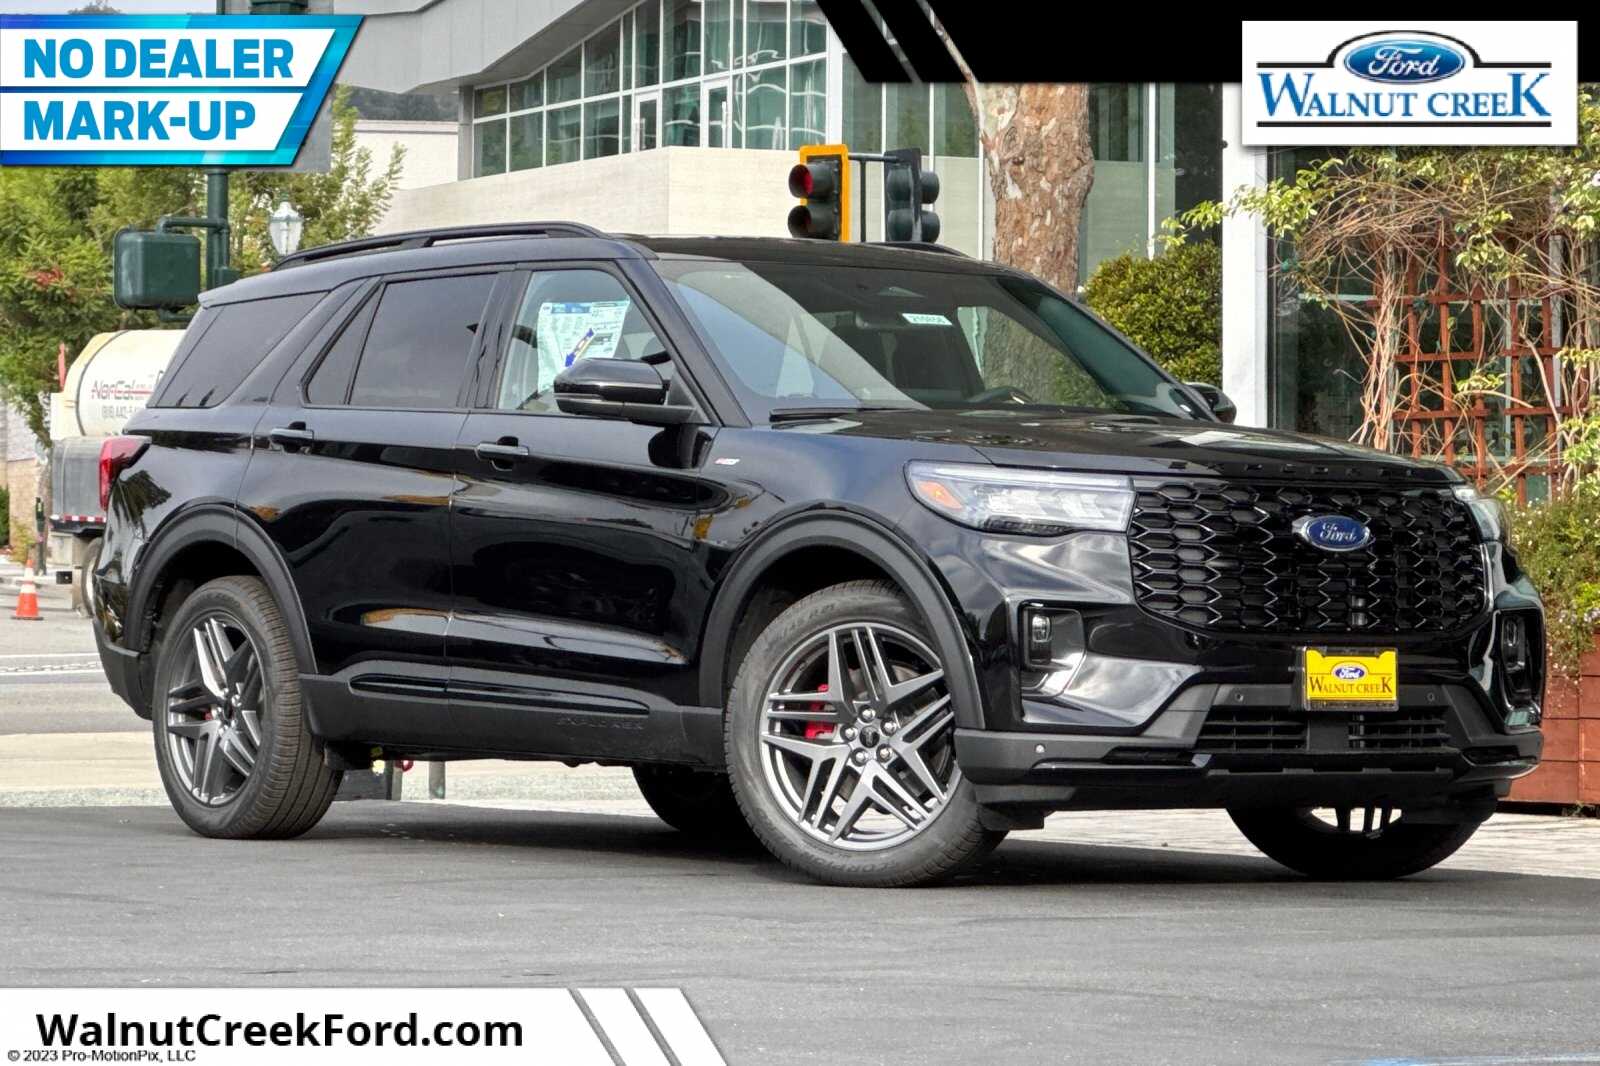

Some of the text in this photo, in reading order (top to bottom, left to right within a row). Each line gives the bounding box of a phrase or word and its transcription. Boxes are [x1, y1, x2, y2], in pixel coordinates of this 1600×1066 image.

[1319, 522, 1358, 542] Ford
[1339, 666, 1361, 679] Ford
[1308, 676, 1393, 694] WALNUT CREEK
